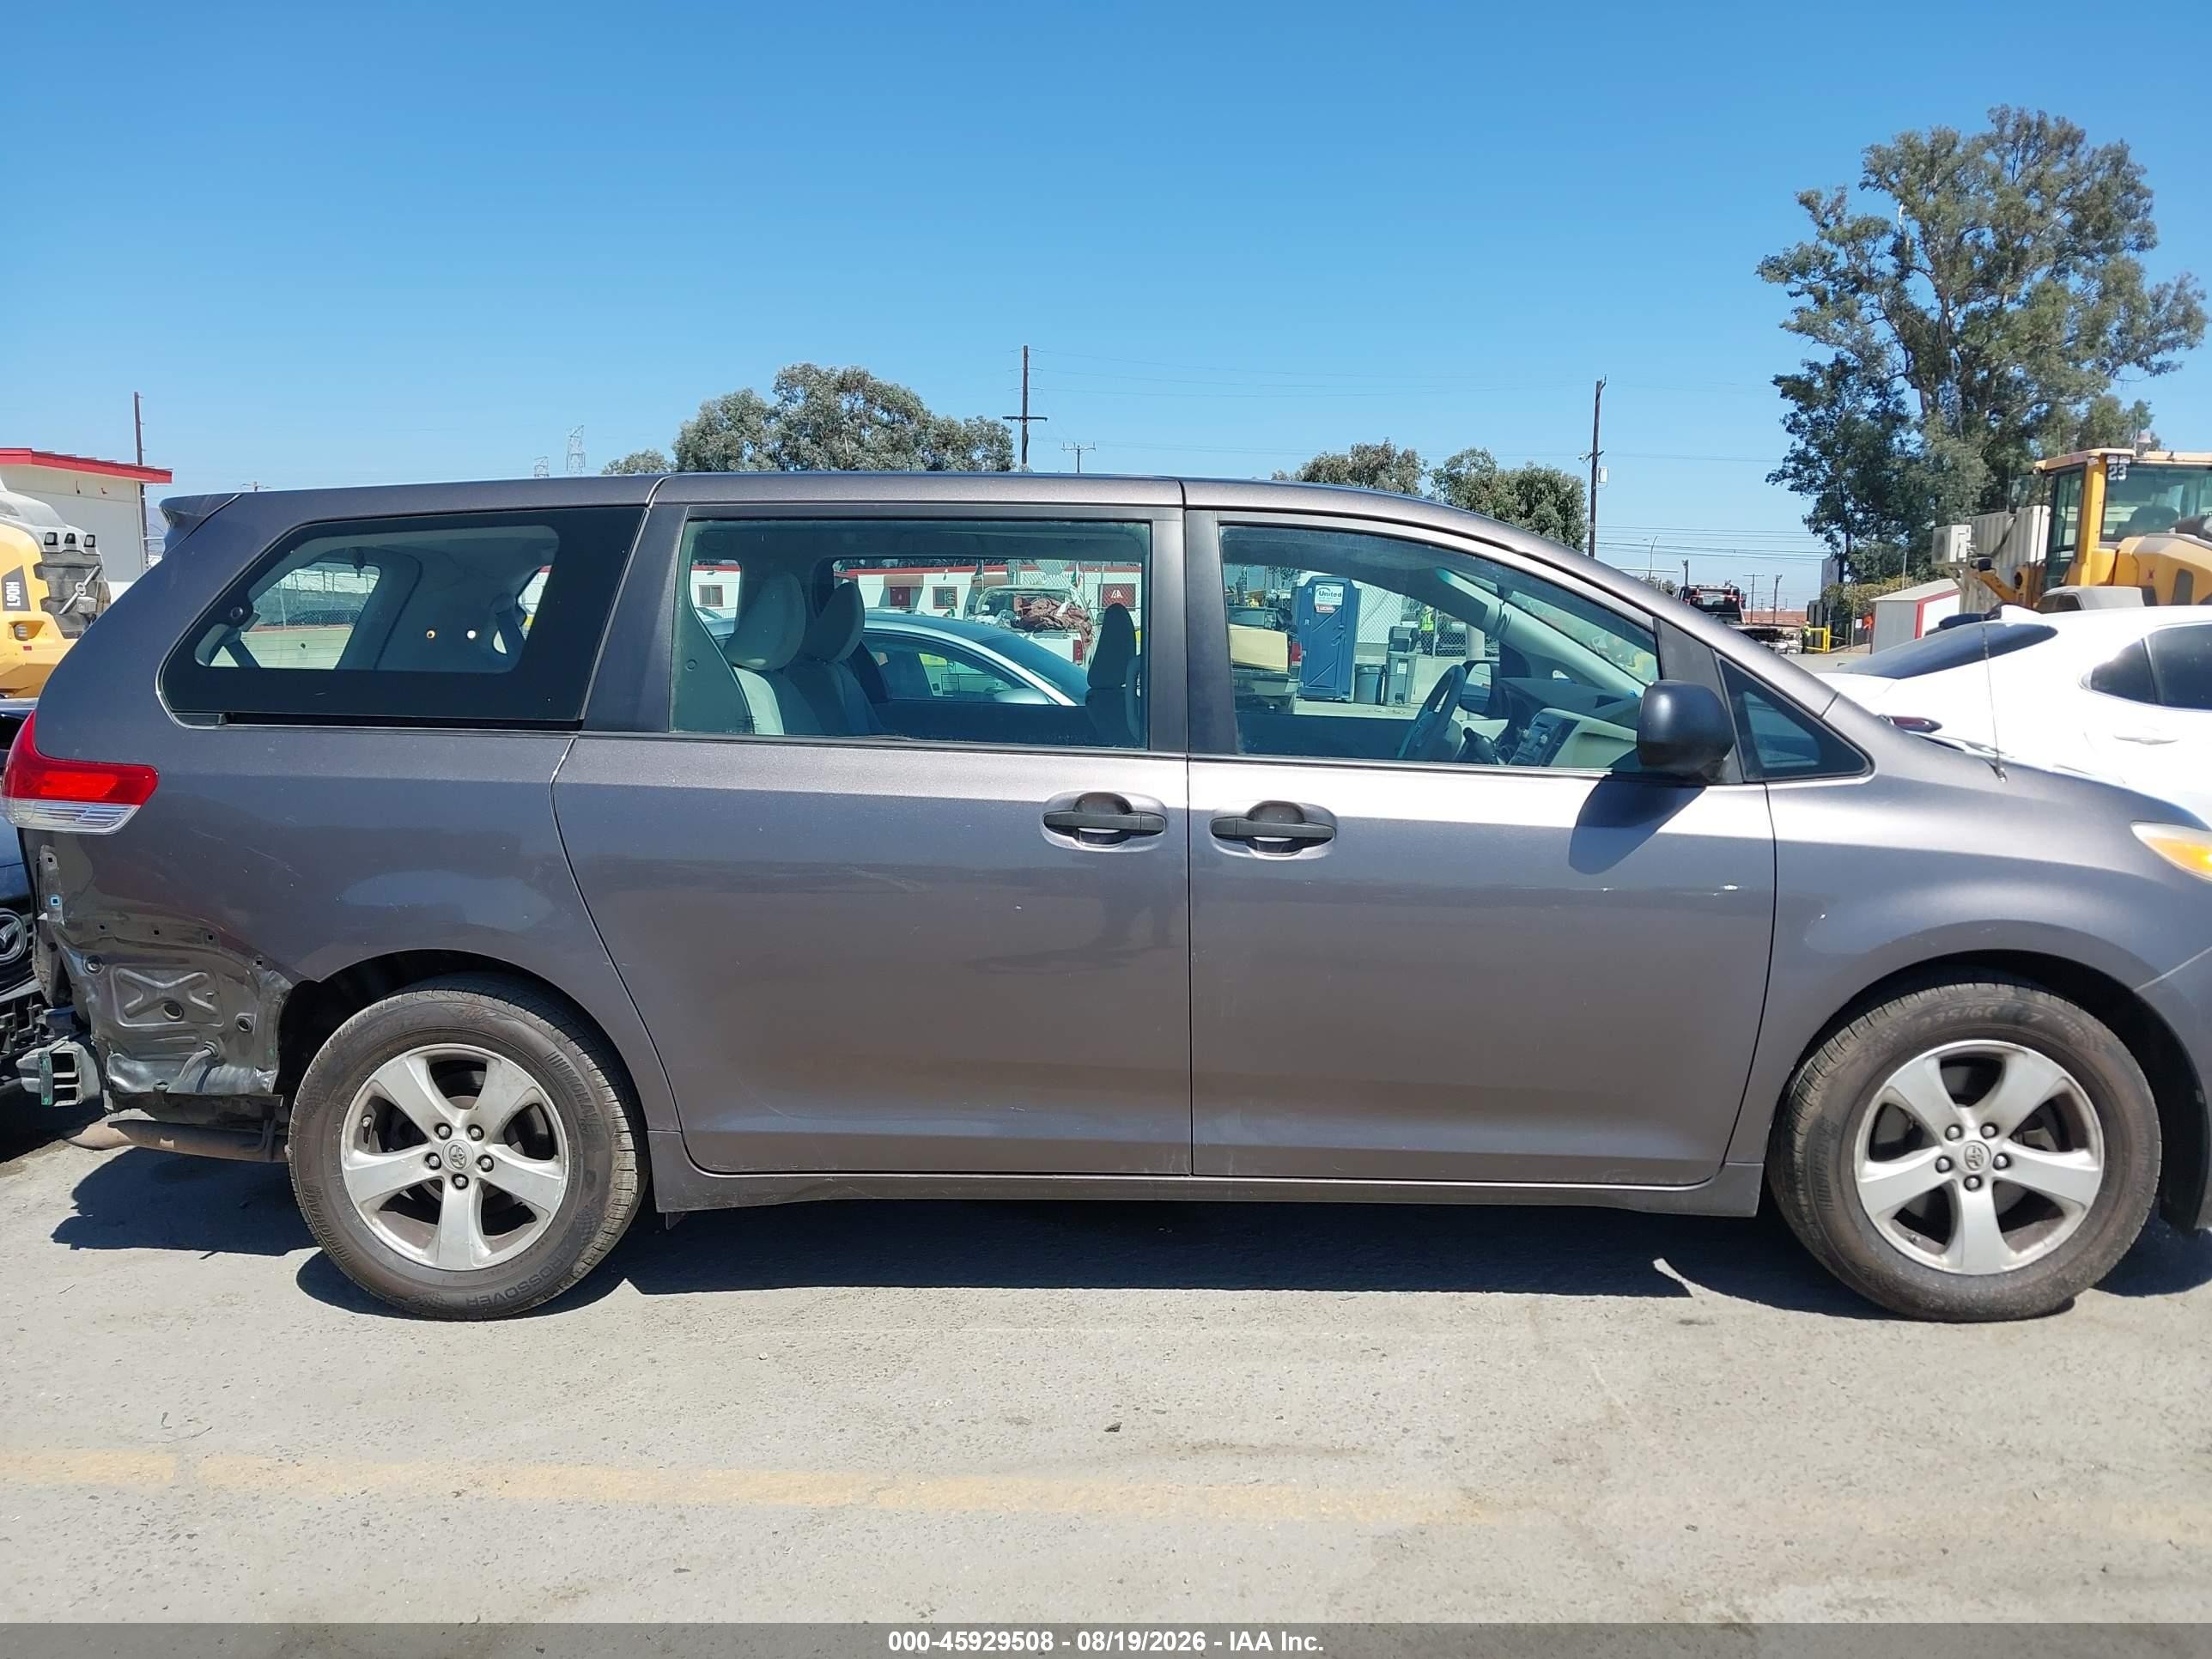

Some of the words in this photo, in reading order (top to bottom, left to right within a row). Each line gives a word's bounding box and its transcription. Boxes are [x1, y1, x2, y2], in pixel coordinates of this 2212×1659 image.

[2108, 465, 2127, 481] 23
[5, 581, 21, 607] L90H
[465, 1246, 575, 1307] CROSSOVER
